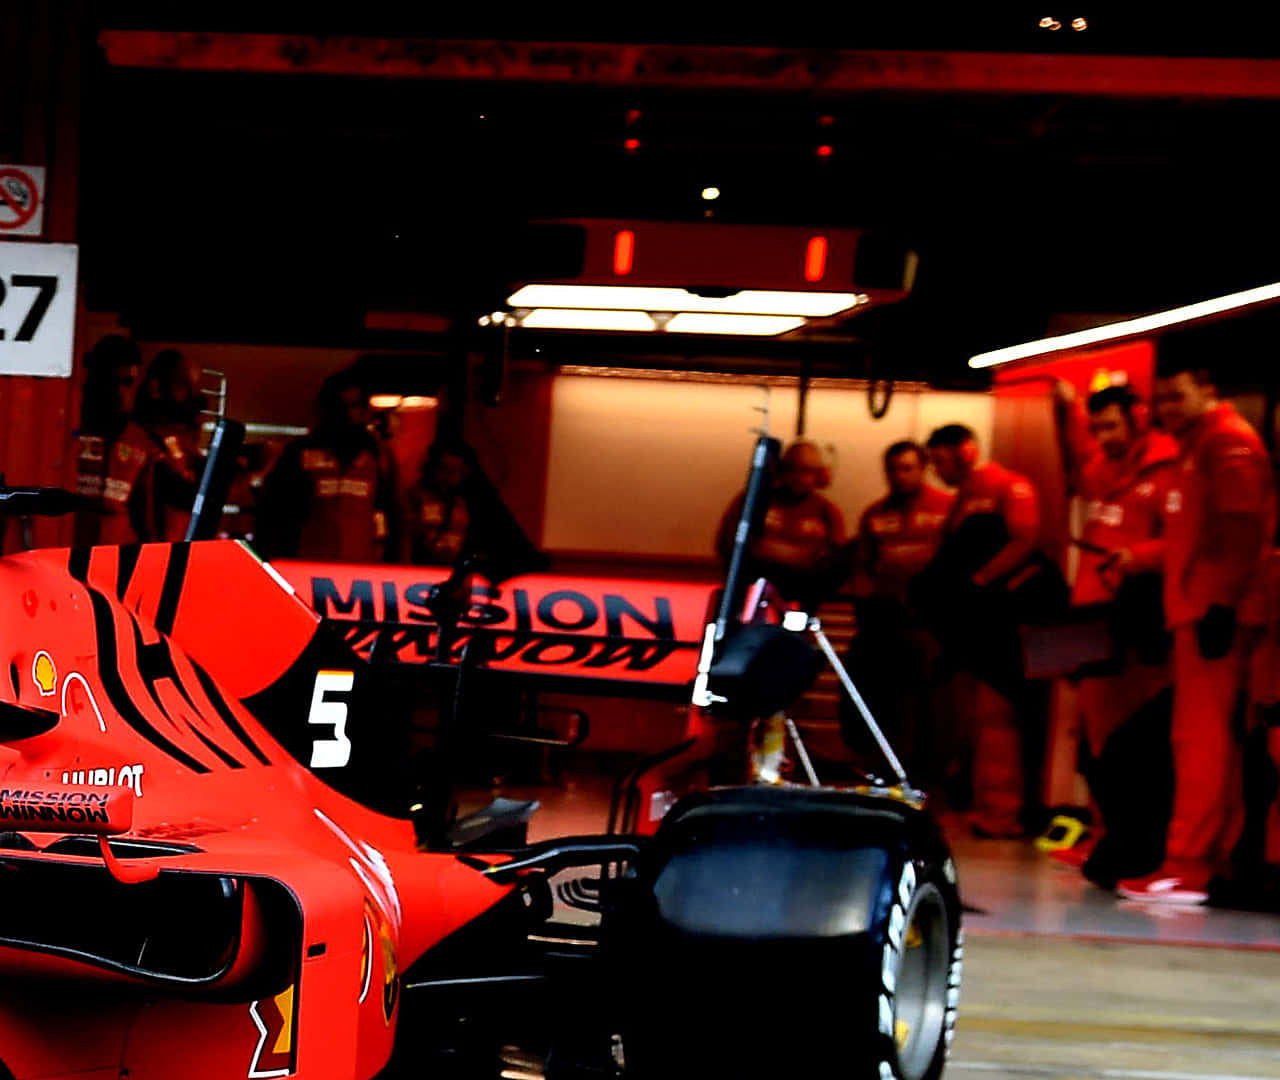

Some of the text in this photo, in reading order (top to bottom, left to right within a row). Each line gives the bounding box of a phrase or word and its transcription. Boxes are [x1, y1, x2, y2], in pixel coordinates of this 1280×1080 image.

[311, 577, 676, 641] MISSION
[307, 670, 355, 769] 5
[0, 789, 109, 807] MISSION
